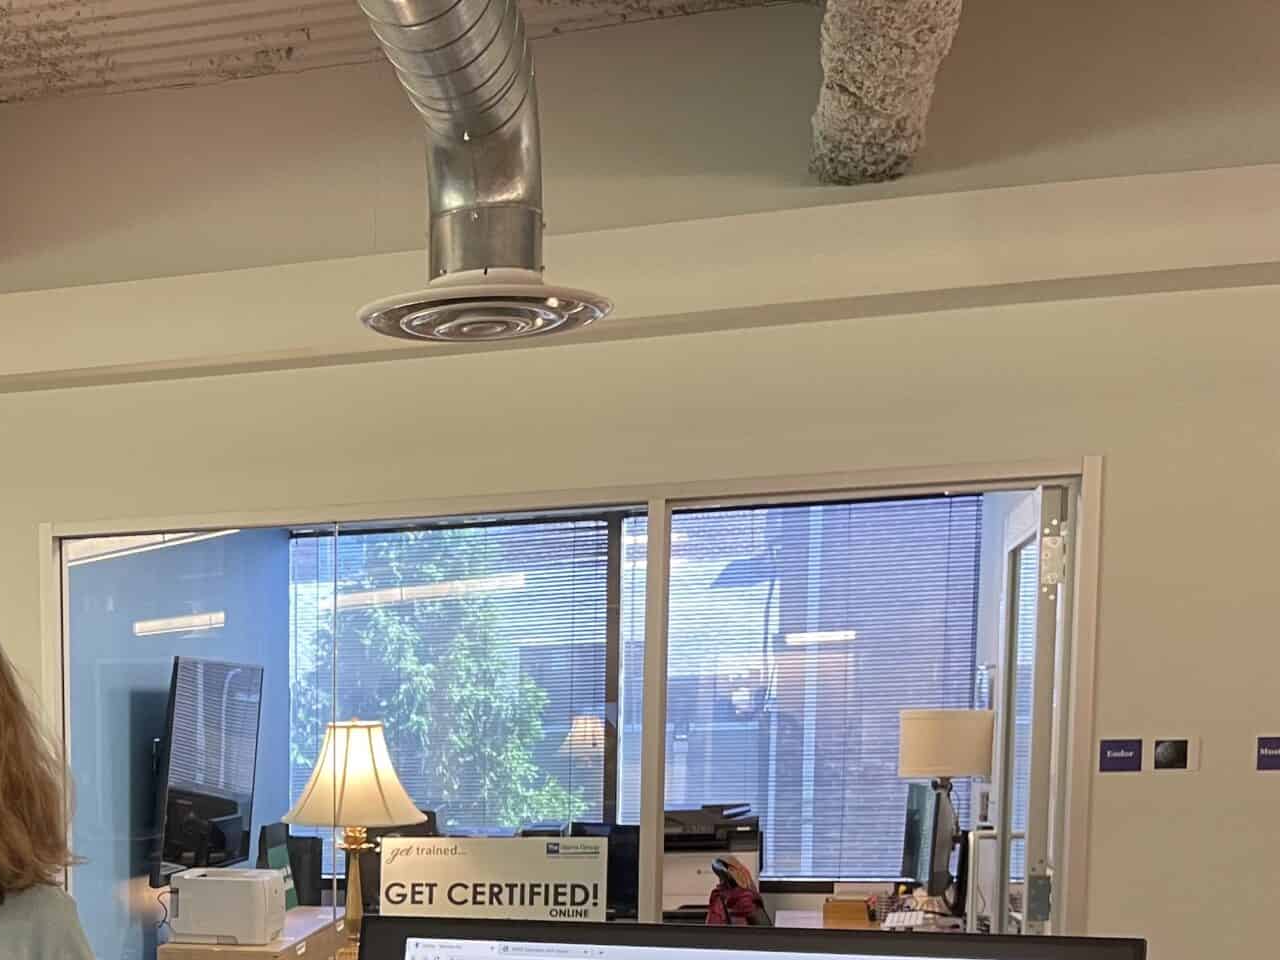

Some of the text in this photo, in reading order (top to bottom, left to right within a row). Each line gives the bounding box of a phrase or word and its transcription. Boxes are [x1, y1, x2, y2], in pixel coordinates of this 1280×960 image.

[386, 844, 414, 864] get
[384, 882, 599, 908] GET CERTIFIED!
[549, 907, 589, 919] ONLINE
